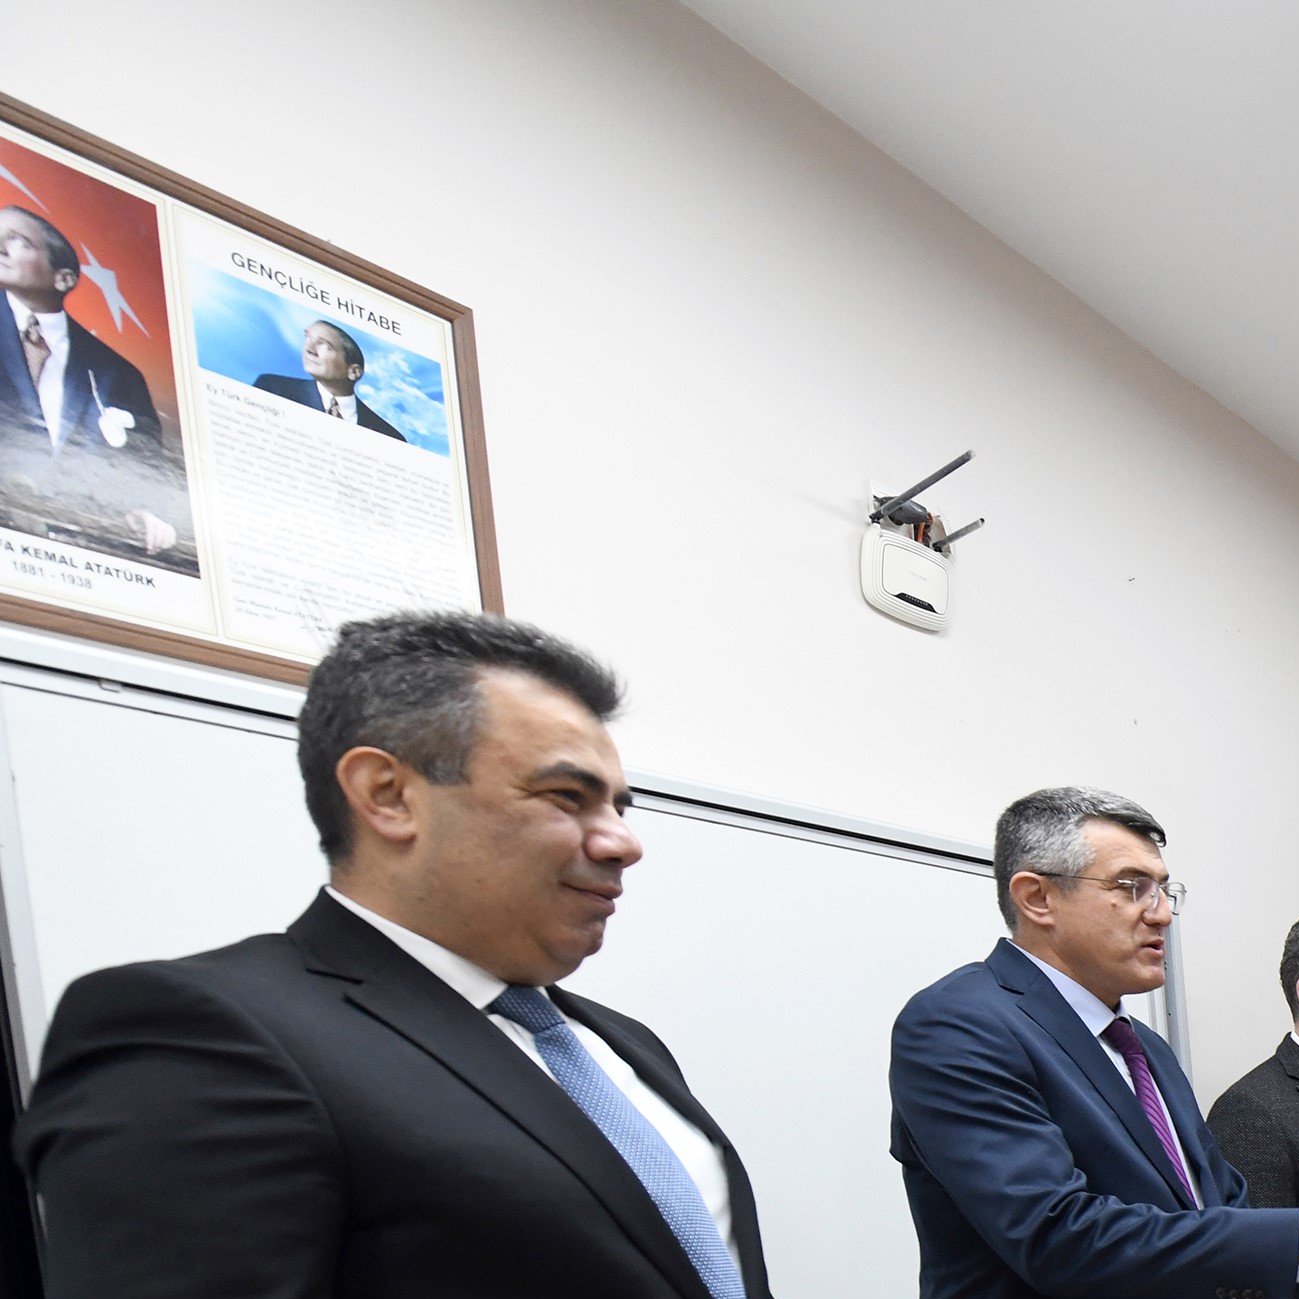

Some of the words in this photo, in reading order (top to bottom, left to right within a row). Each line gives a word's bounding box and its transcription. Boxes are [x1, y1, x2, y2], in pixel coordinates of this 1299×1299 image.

[231, 252, 331, 306] GENÇLİĞE
[337, 297, 402, 336] HİTABE
[21, 543, 78, 569] KEMAL
[84, 561, 156, 588] ATATÜRK
